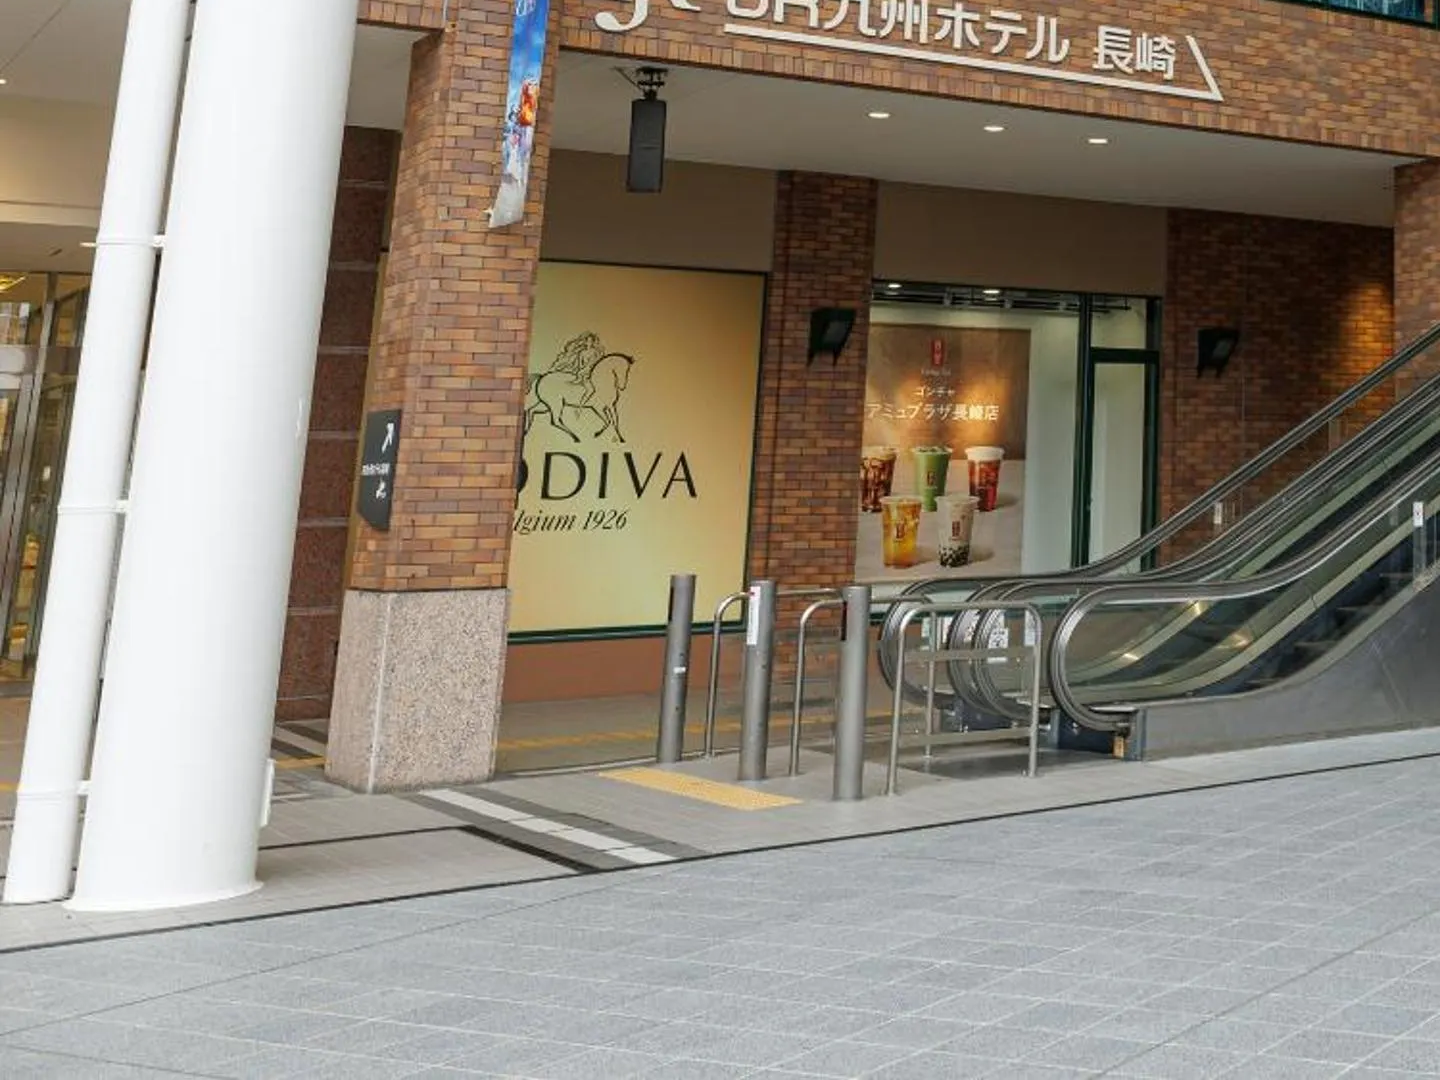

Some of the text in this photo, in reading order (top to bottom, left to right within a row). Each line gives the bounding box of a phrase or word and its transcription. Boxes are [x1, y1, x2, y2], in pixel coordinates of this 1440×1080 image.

[1092, 24, 1176, 81] 長崎
[518, 451, 698, 501] DIVA
[582, 508, 630, 531] 1926
